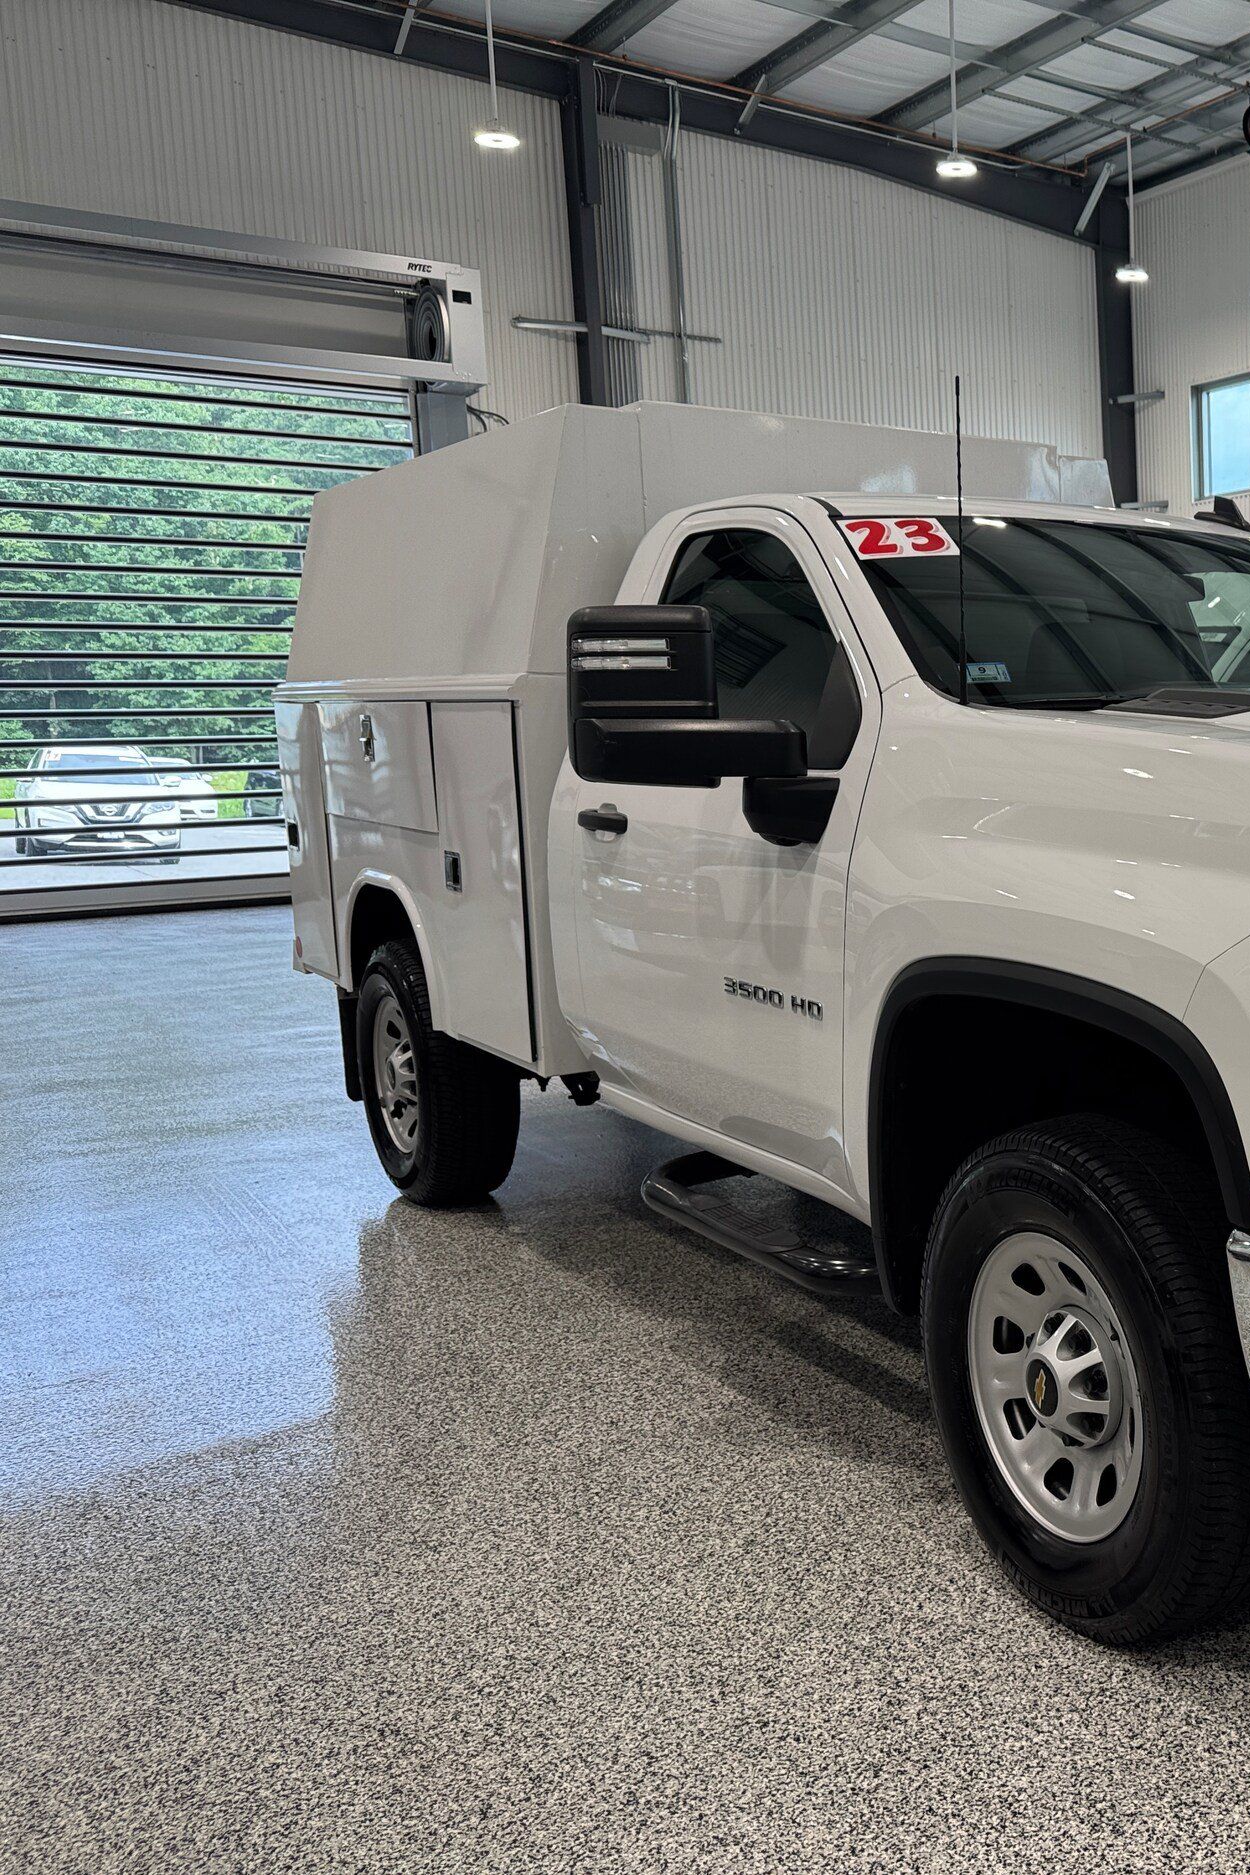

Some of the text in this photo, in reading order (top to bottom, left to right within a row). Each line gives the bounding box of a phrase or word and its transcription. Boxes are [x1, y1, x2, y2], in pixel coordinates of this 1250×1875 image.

[407, 262, 433, 273] RYTEC
[844, 518, 949, 556] 23
[723, 976, 823, 1021] 3500 HD
